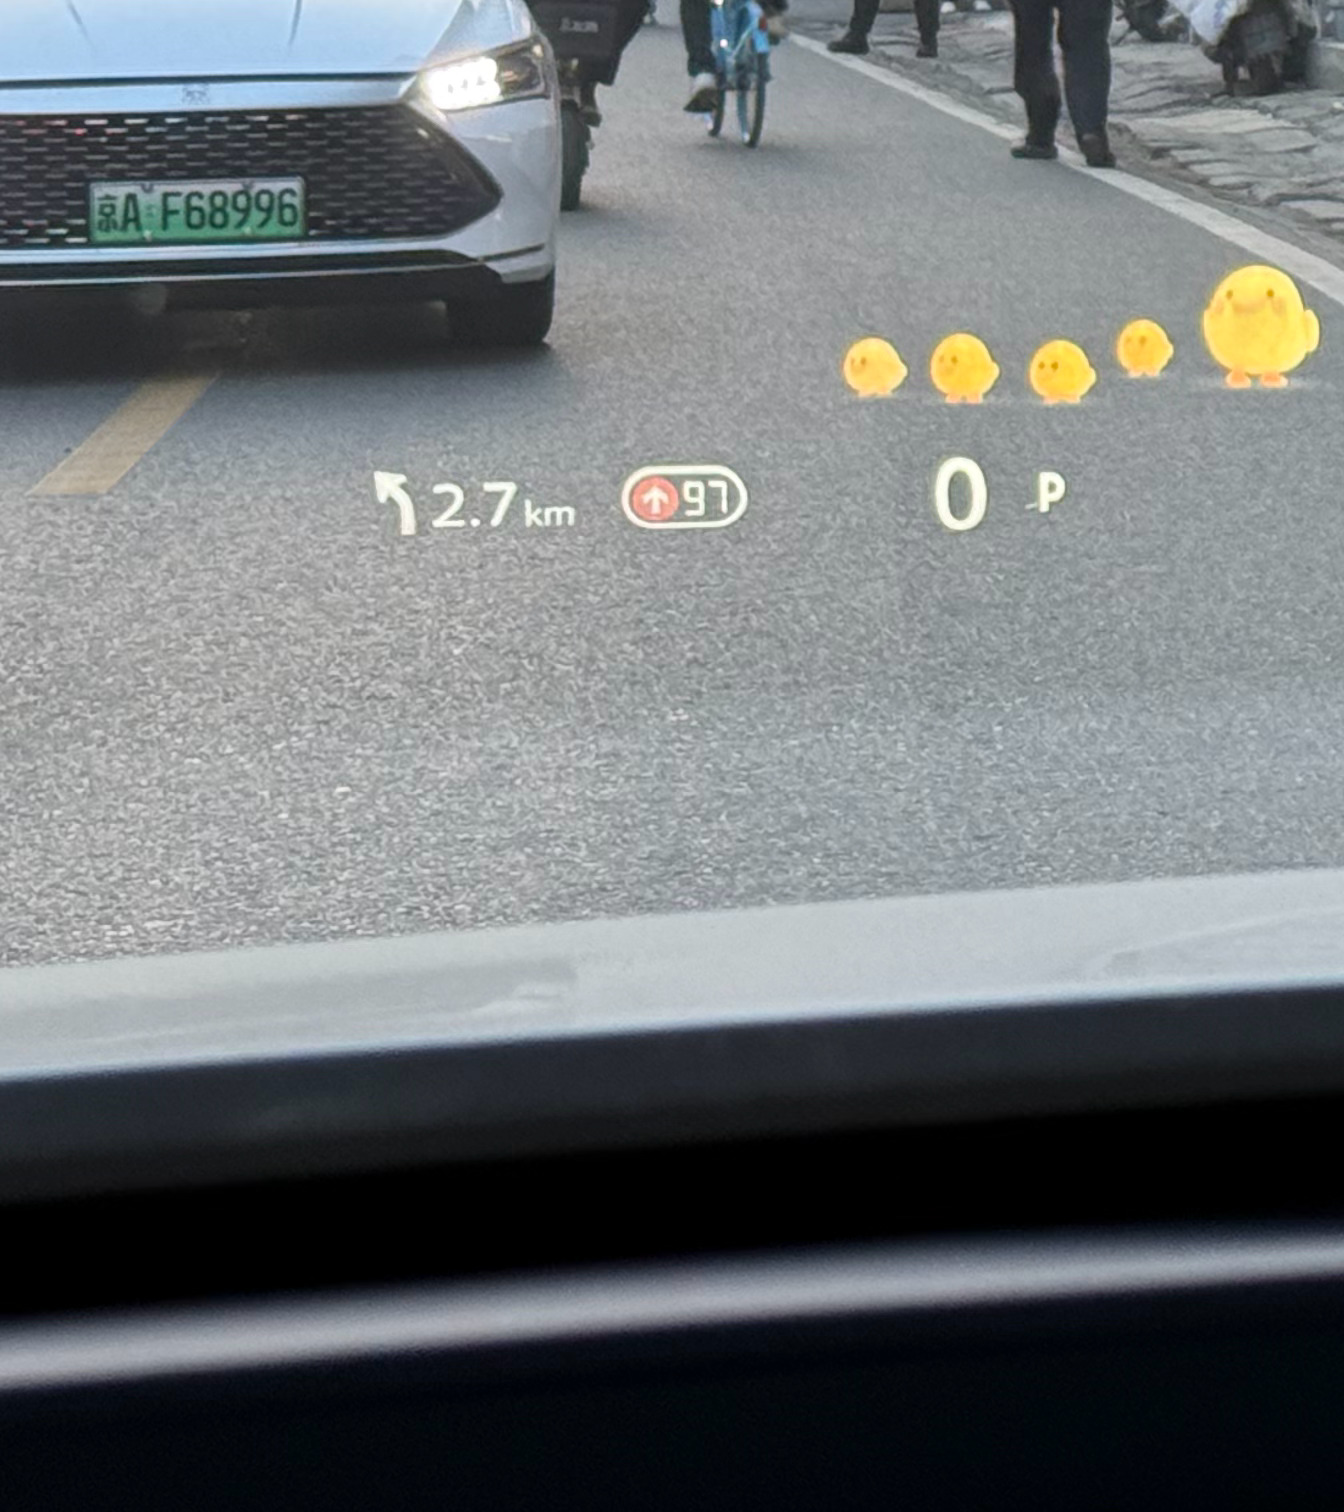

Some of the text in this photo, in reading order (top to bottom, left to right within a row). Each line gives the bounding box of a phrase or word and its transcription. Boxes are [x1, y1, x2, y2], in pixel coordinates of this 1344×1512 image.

[432, 482, 576, 529] 2.7 km
[682, 480, 729, 517] 97
[933, 455, 988, 530] 0
[1037, 472, 1066, 514] P
